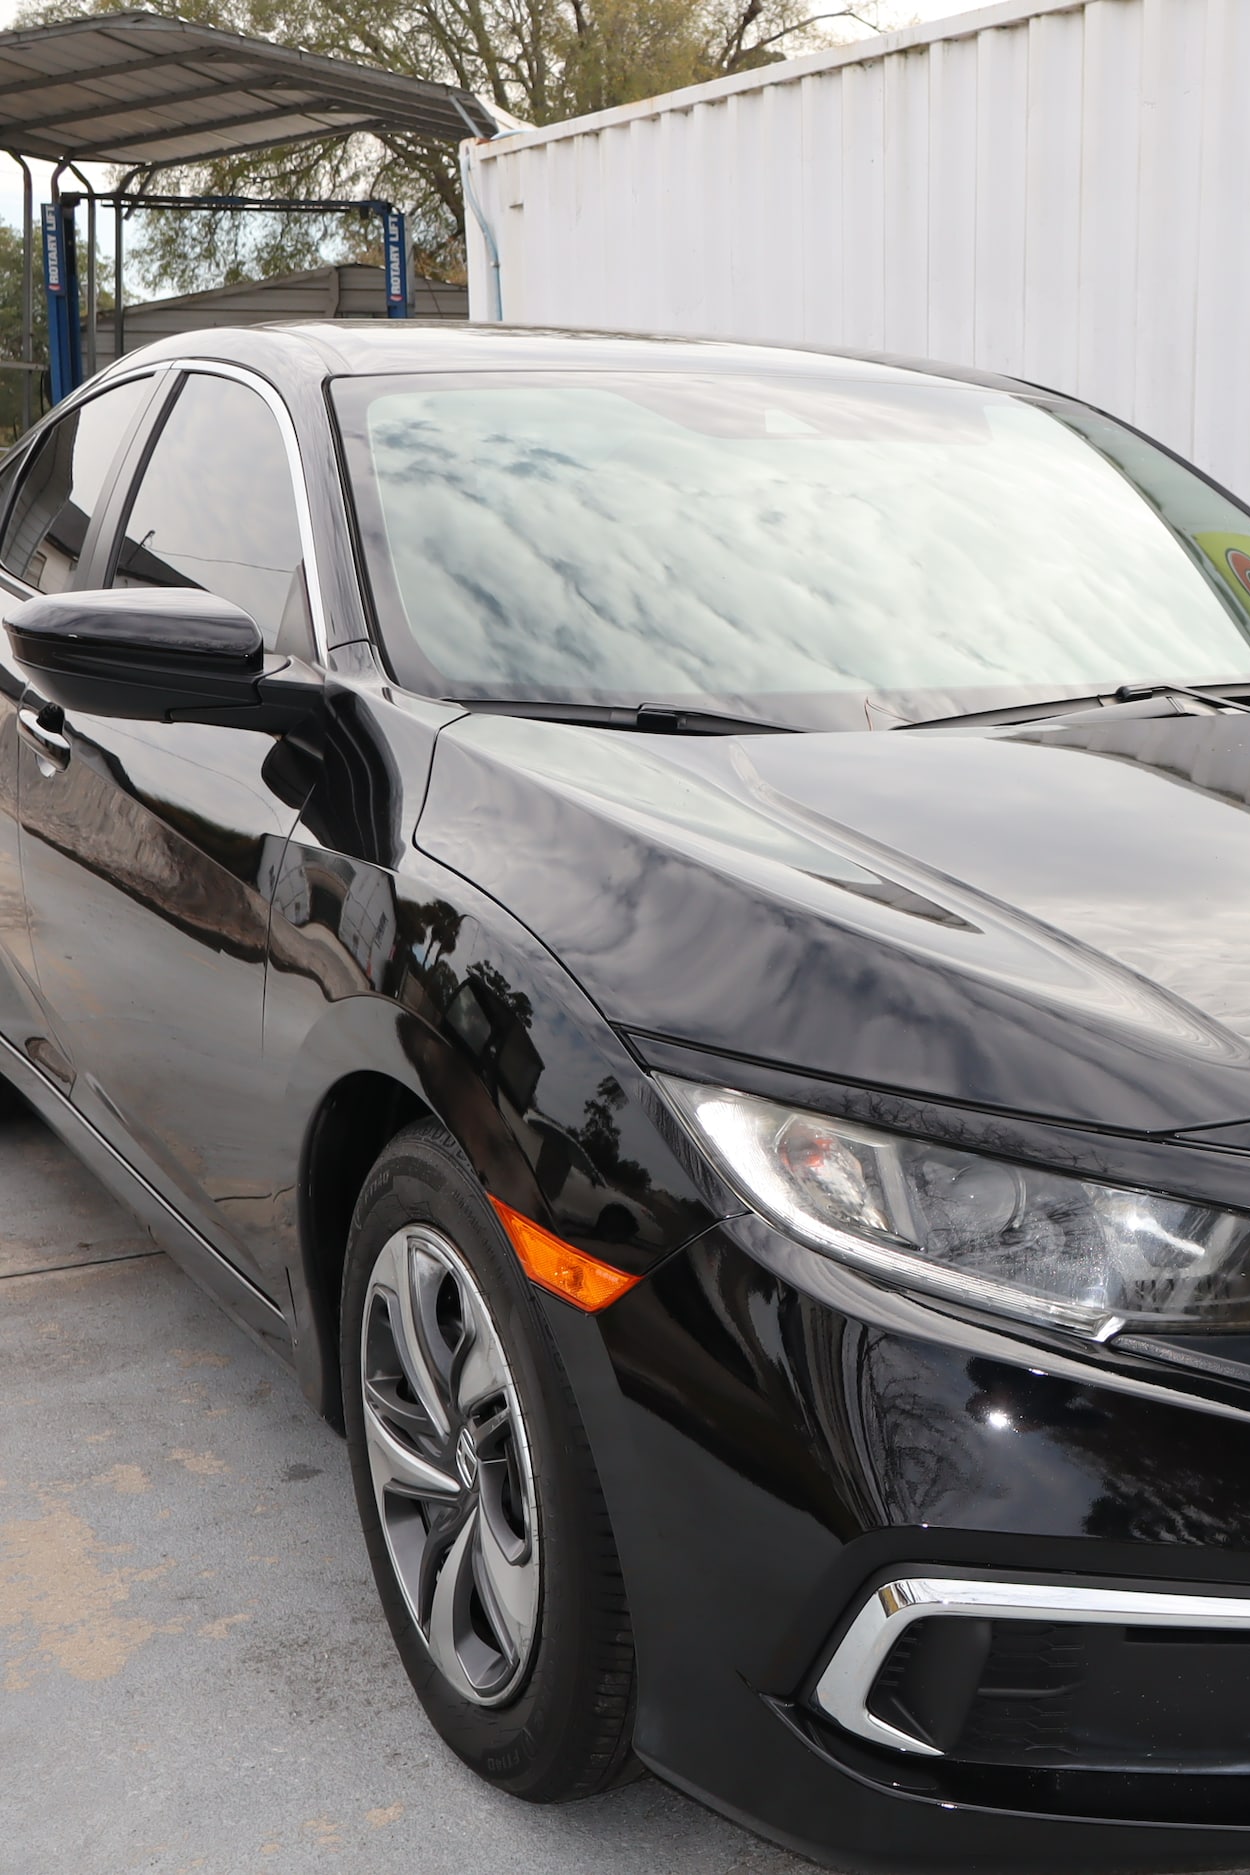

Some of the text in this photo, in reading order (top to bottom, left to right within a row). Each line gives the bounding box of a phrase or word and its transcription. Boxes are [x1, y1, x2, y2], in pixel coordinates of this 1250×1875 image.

[45, 204, 60, 285] ROTARY LIFT
[388, 214, 402, 295] ROTARY LIFT
